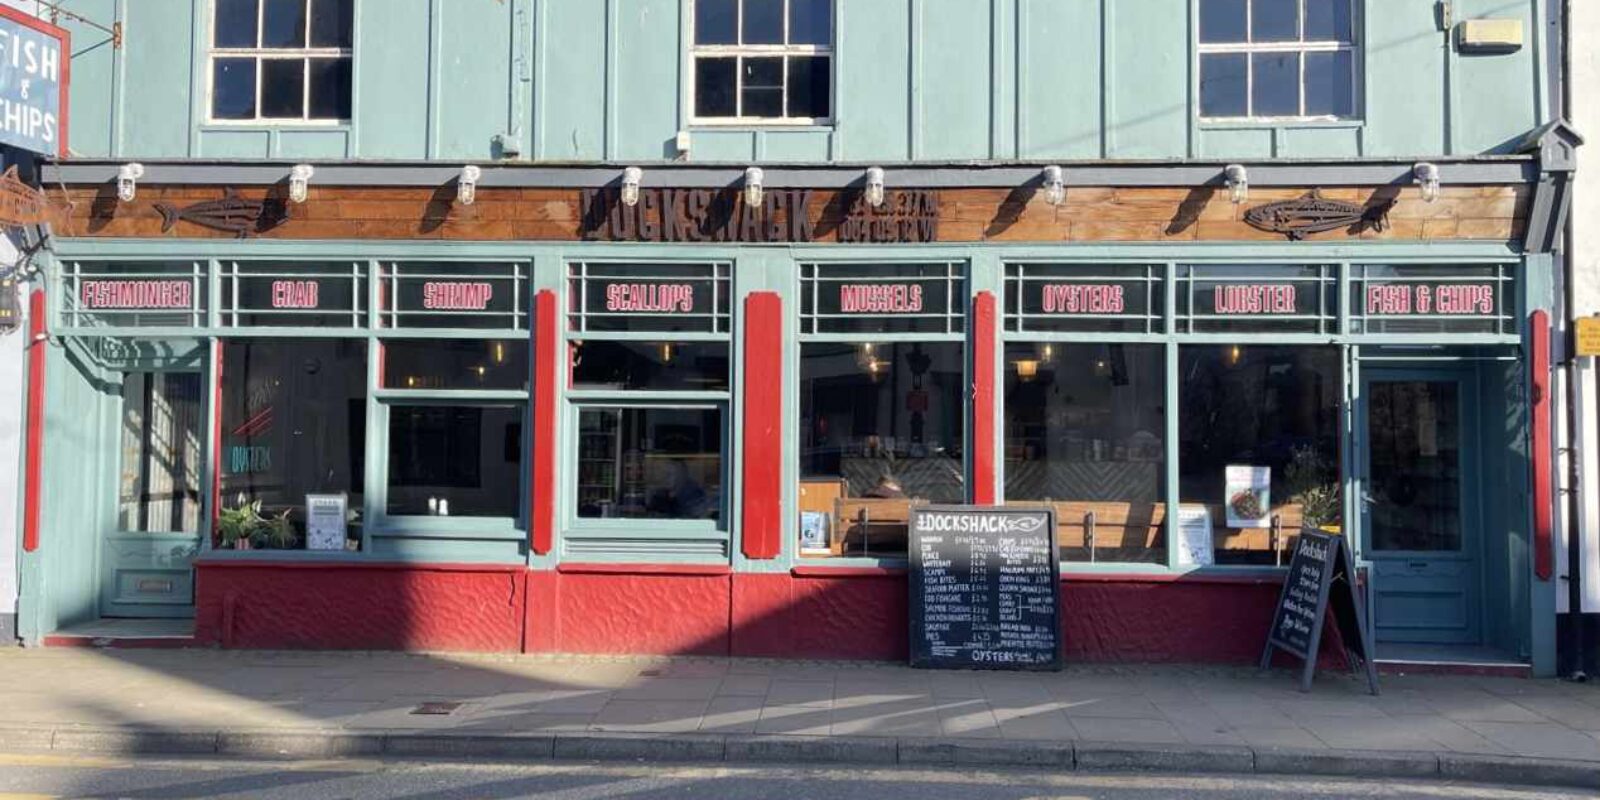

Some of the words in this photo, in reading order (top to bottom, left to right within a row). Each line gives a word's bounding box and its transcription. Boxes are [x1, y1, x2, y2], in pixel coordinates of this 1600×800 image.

[21, 79, 30, 99] &
[0, 97, 55, 142] HIPS
[81, 280, 191, 308] FISHMONGER
[272, 280, 318, 308] CRAB
[423, 282, 492, 309] SHRIMP
[606, 283, 693, 312] SCALLOPS
[840, 284, 922, 313] MUSSELS
[1042, 285, 1124, 313] OYSTERS
[1215, 285, 1296, 313] LOBSTER
[1368, 285, 1410, 313] FISH
[1416, 285, 1431, 313] &
[1436, 285, 1493, 313] CHIPS
[927, 513, 1008, 533] DOCKSHACK
[972, 650, 1013, 662] OYSTERS
